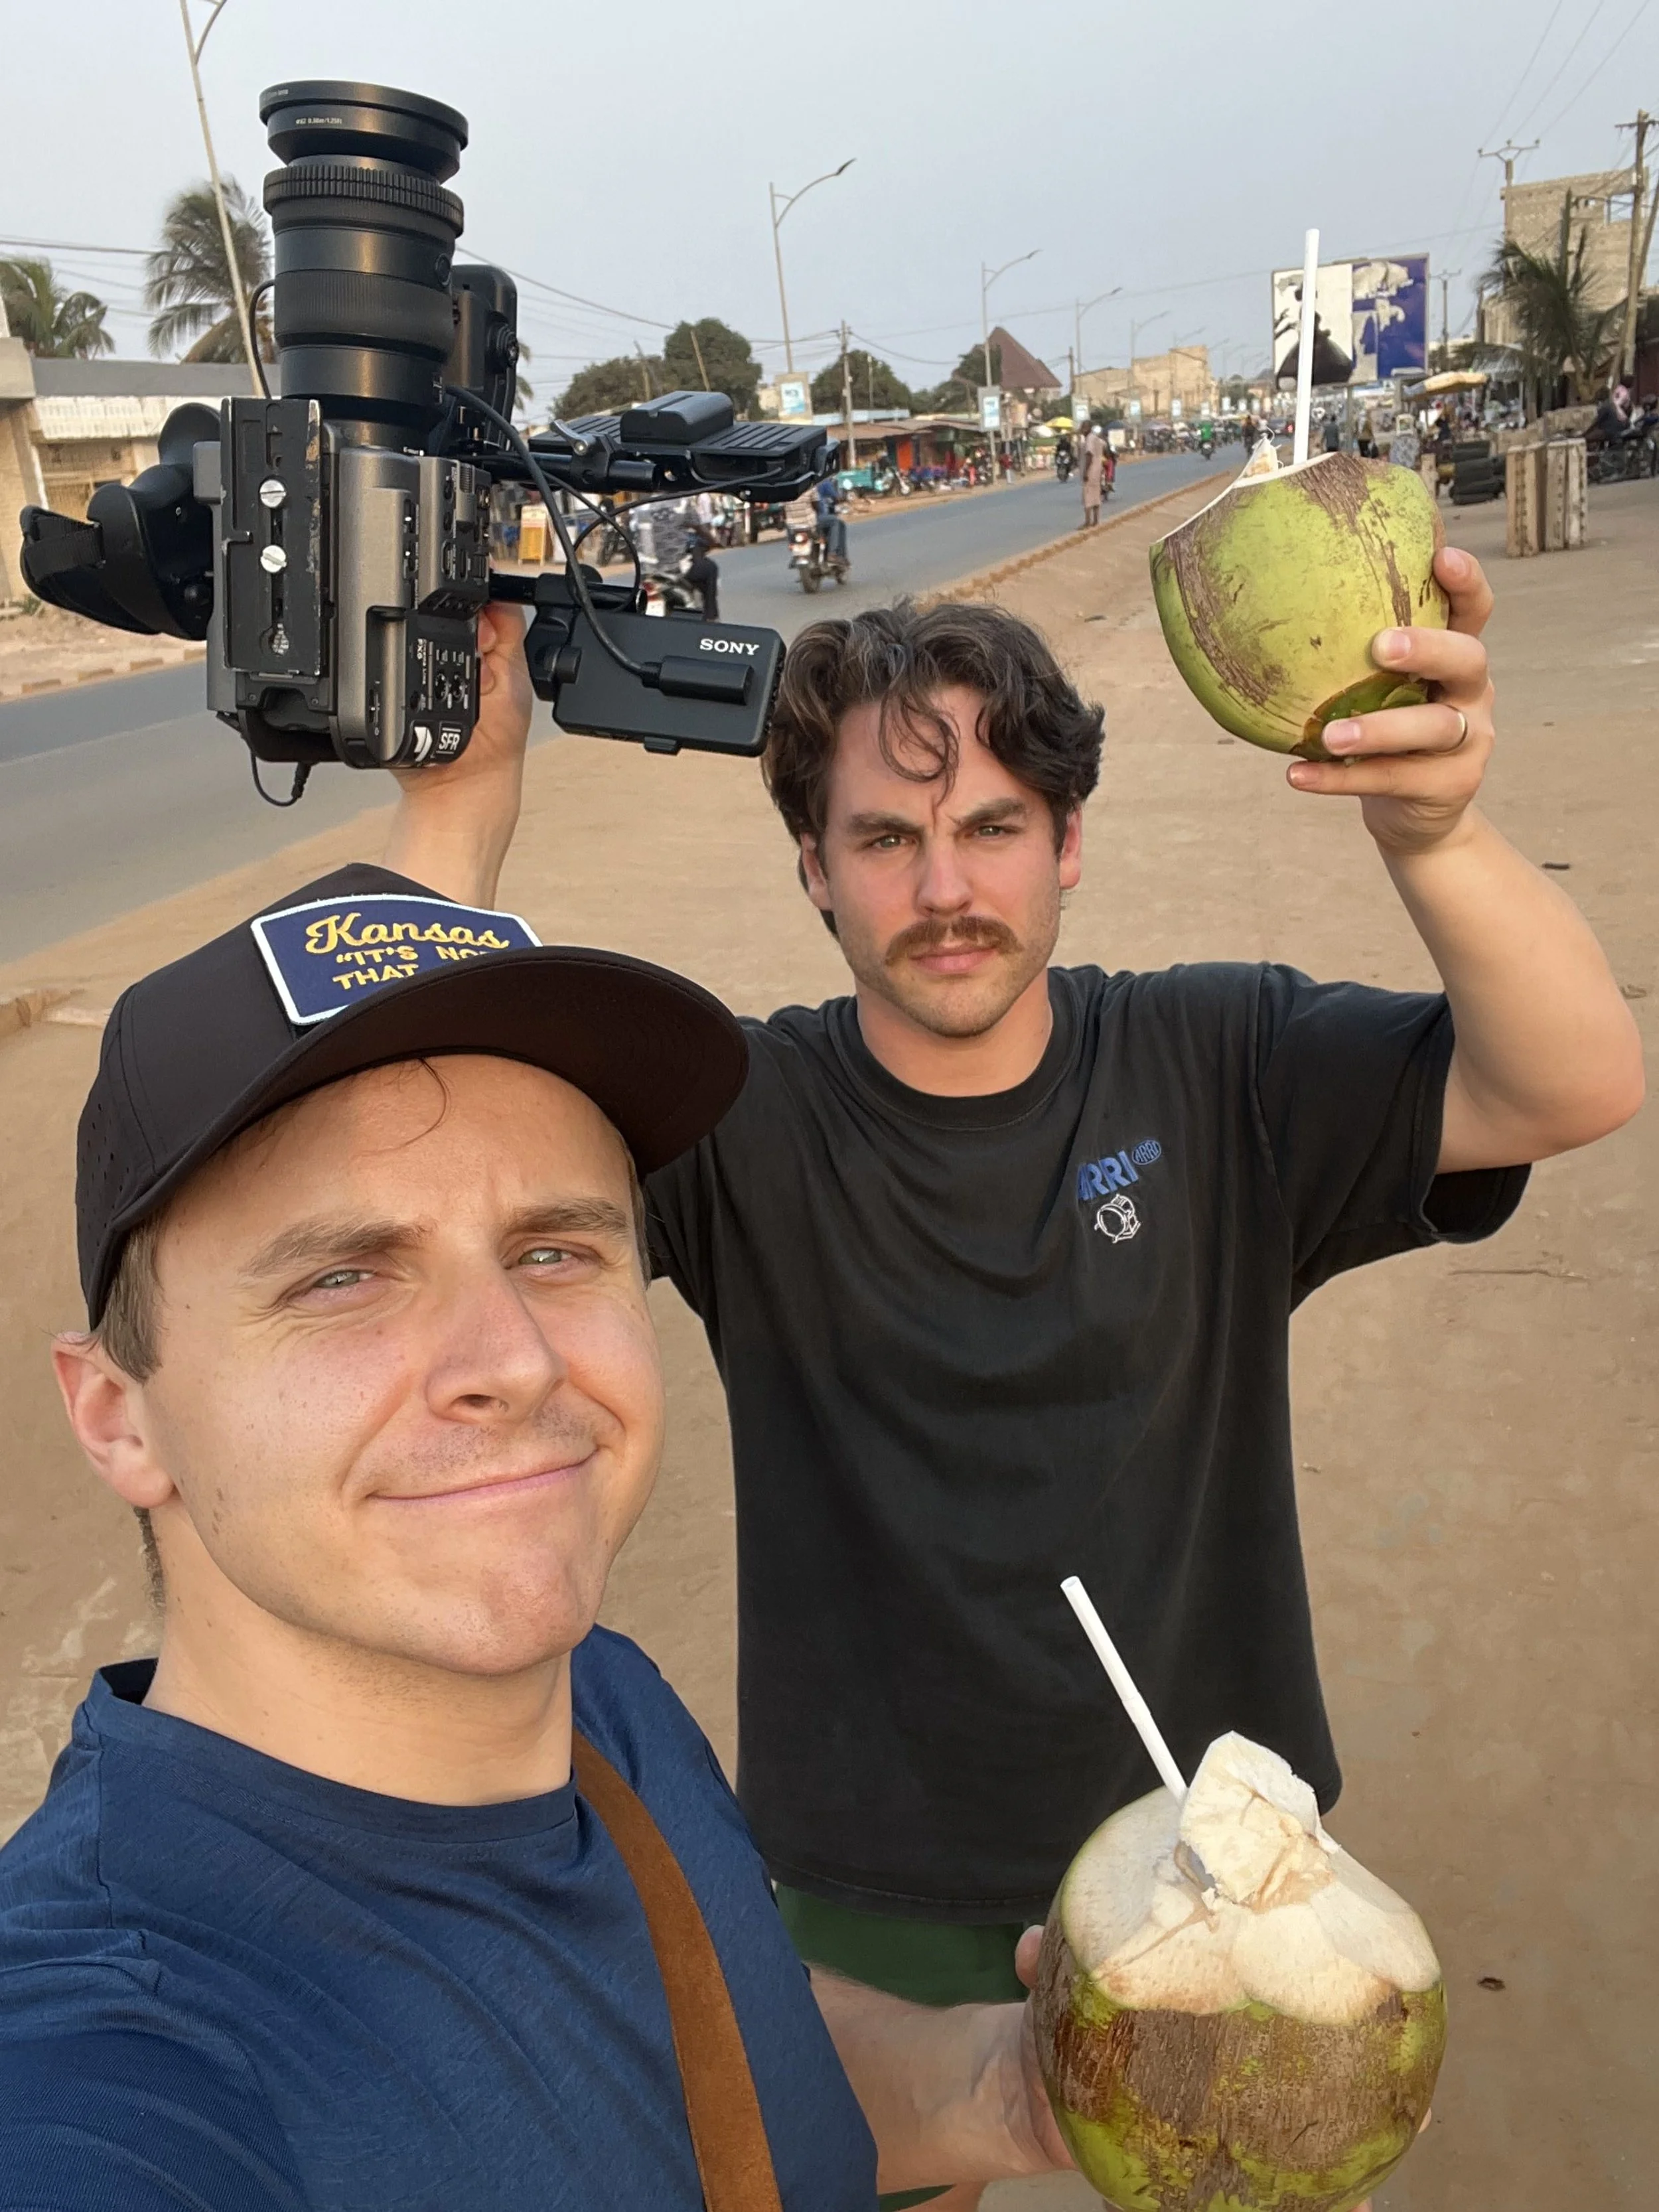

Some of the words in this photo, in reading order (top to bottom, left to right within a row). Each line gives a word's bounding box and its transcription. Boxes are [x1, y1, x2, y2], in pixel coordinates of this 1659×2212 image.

[699, 638, 760, 656] SONY
[438, 732, 461, 751] SFR
[305, 912, 510, 954] Kansas
[435, 945, 490, 961] NO
[332, 963, 419, 990] THAT
[1077, 1149, 1139, 1201] ARRI
